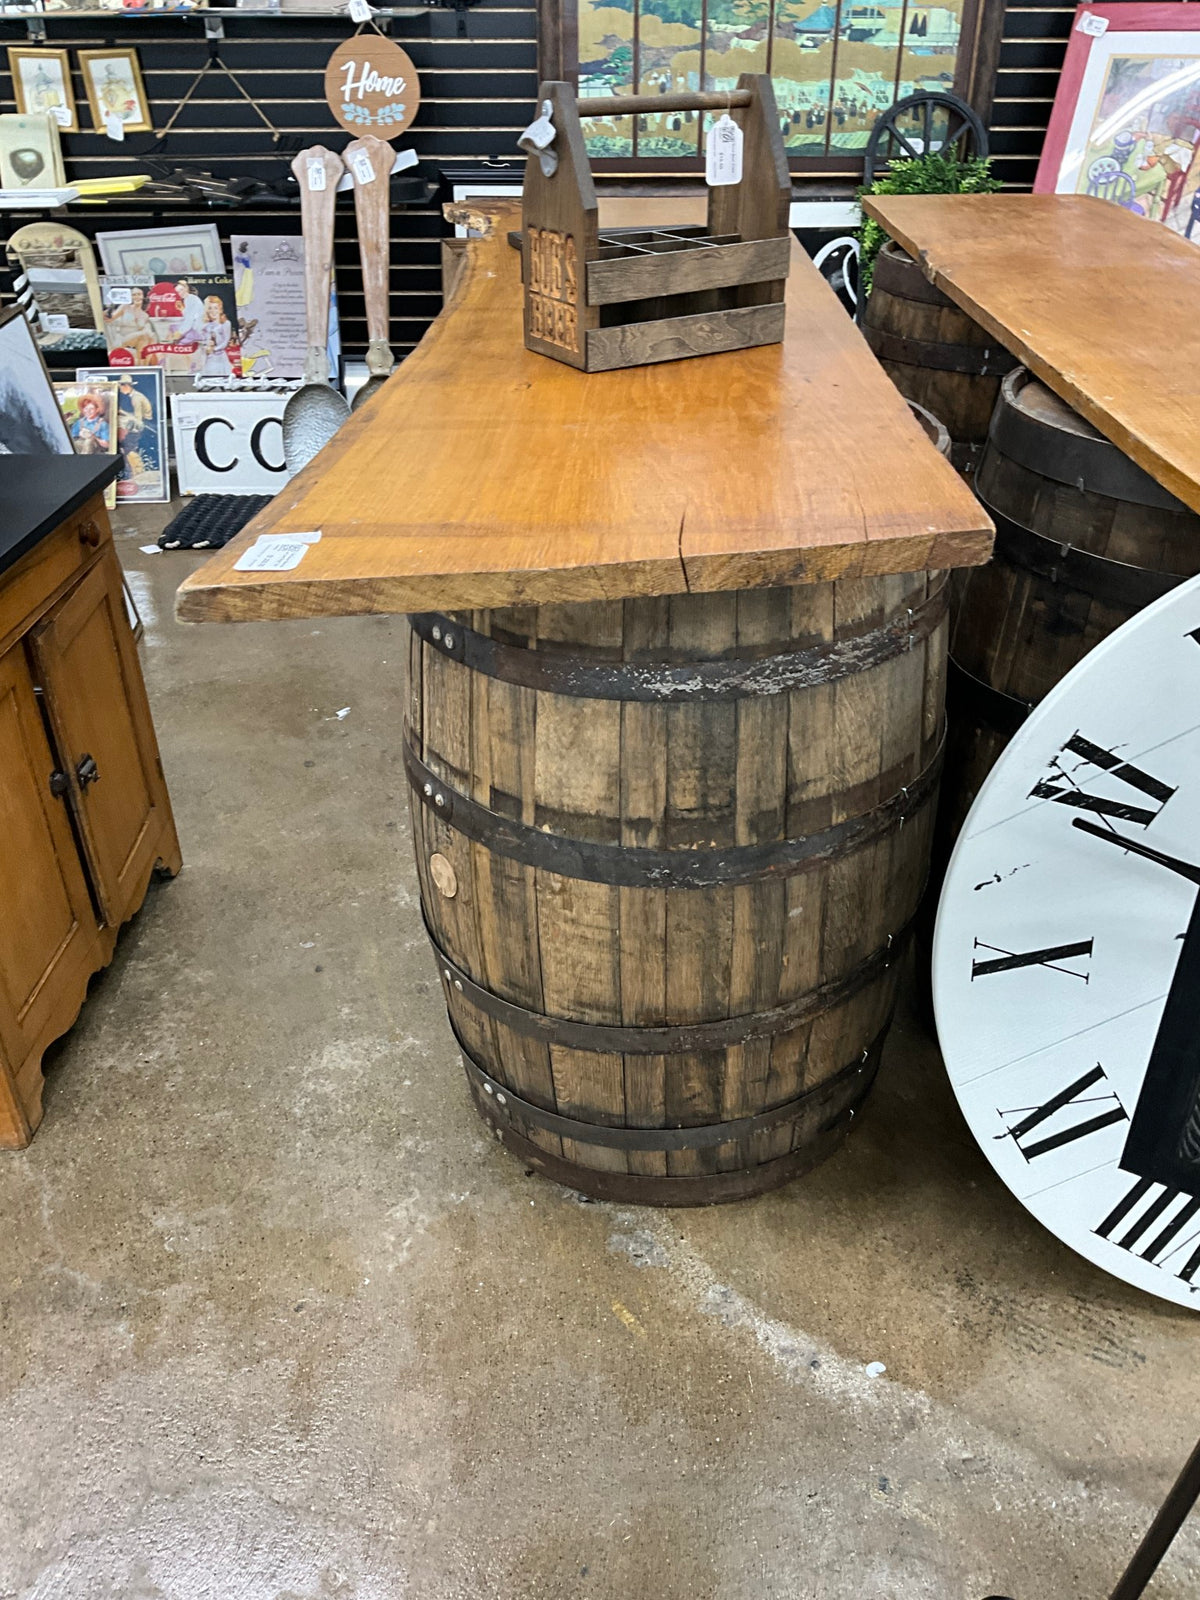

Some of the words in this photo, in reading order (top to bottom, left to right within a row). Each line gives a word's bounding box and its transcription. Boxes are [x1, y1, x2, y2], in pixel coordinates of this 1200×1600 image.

[340, 61, 407, 102] Home
[529, 292, 579, 353] BEER
[971, 936, 1095, 986] X
